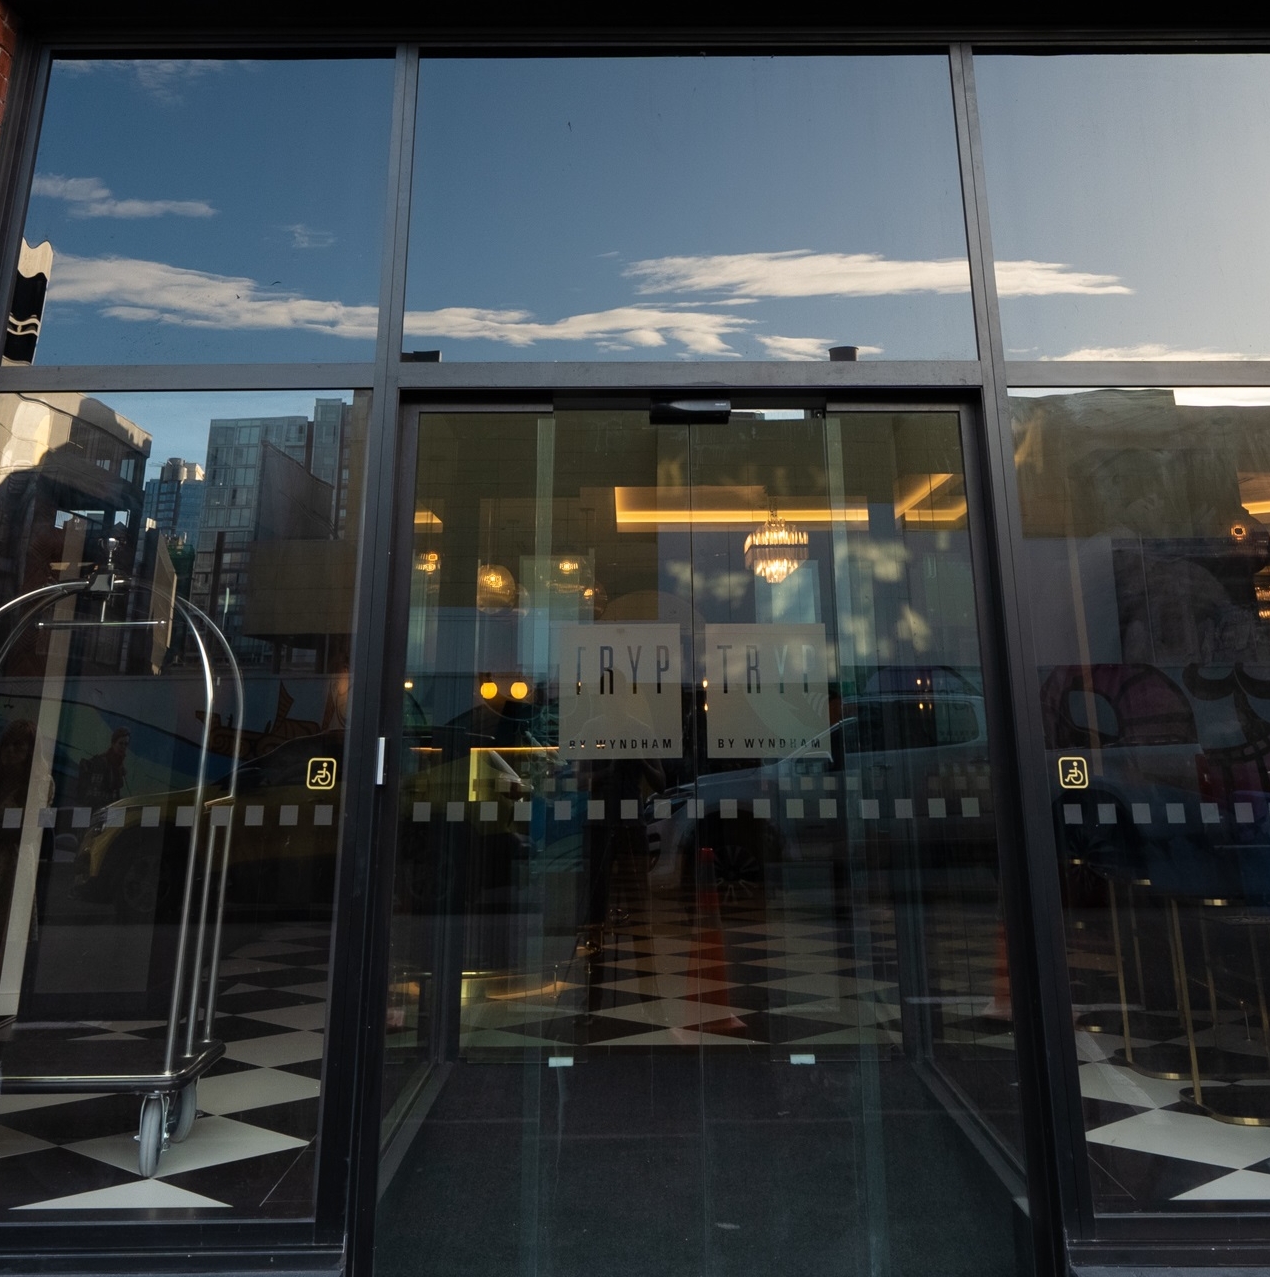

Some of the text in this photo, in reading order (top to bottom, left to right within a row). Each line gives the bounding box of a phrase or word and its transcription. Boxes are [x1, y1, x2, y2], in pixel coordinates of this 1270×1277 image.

[573, 645, 670, 695] TRYP
[716, 644, 816, 694] TRYP
[568, 738, 672, 750] BY WYNDHAM
[717, 738, 821, 749] BY WYNDHAM
